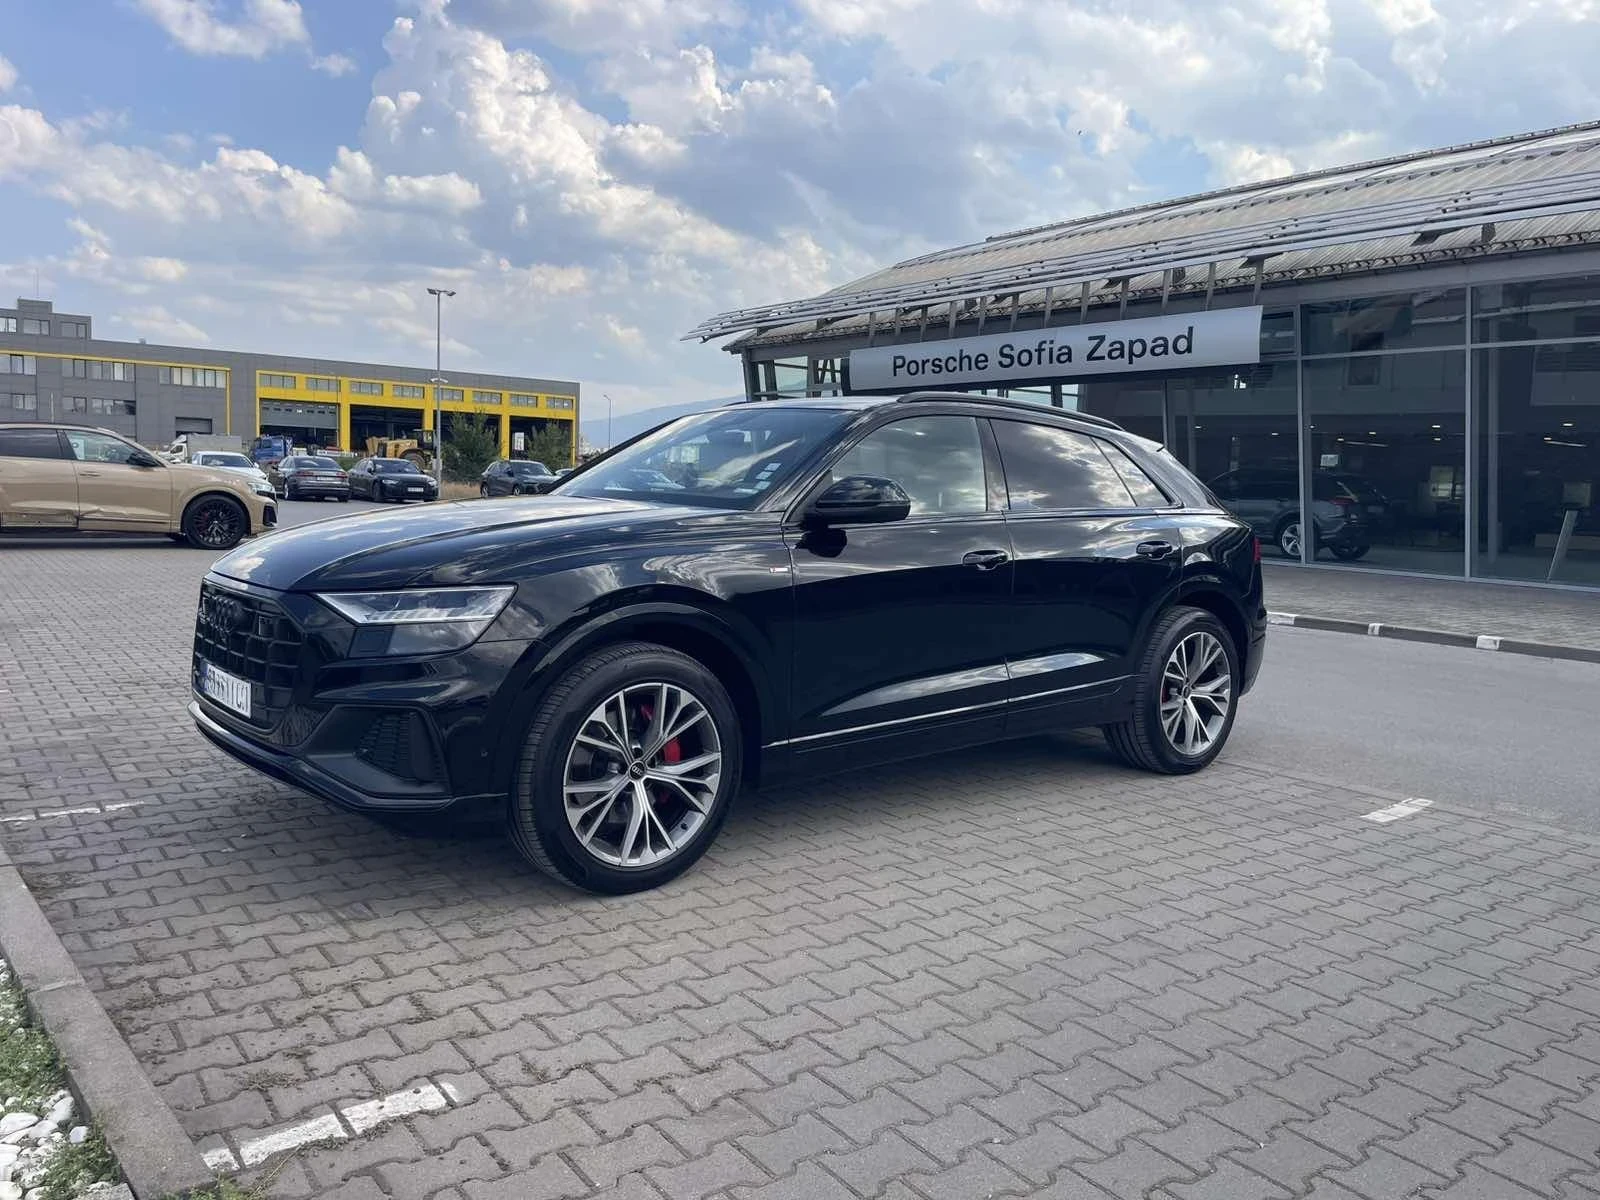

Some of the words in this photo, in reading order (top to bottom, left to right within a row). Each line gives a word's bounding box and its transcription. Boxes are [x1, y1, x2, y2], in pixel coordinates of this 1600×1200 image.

[892, 349, 989, 377] Porsche
[998, 340, 1073, 369] Sofia
[1086, 326, 1194, 365] Zapad
